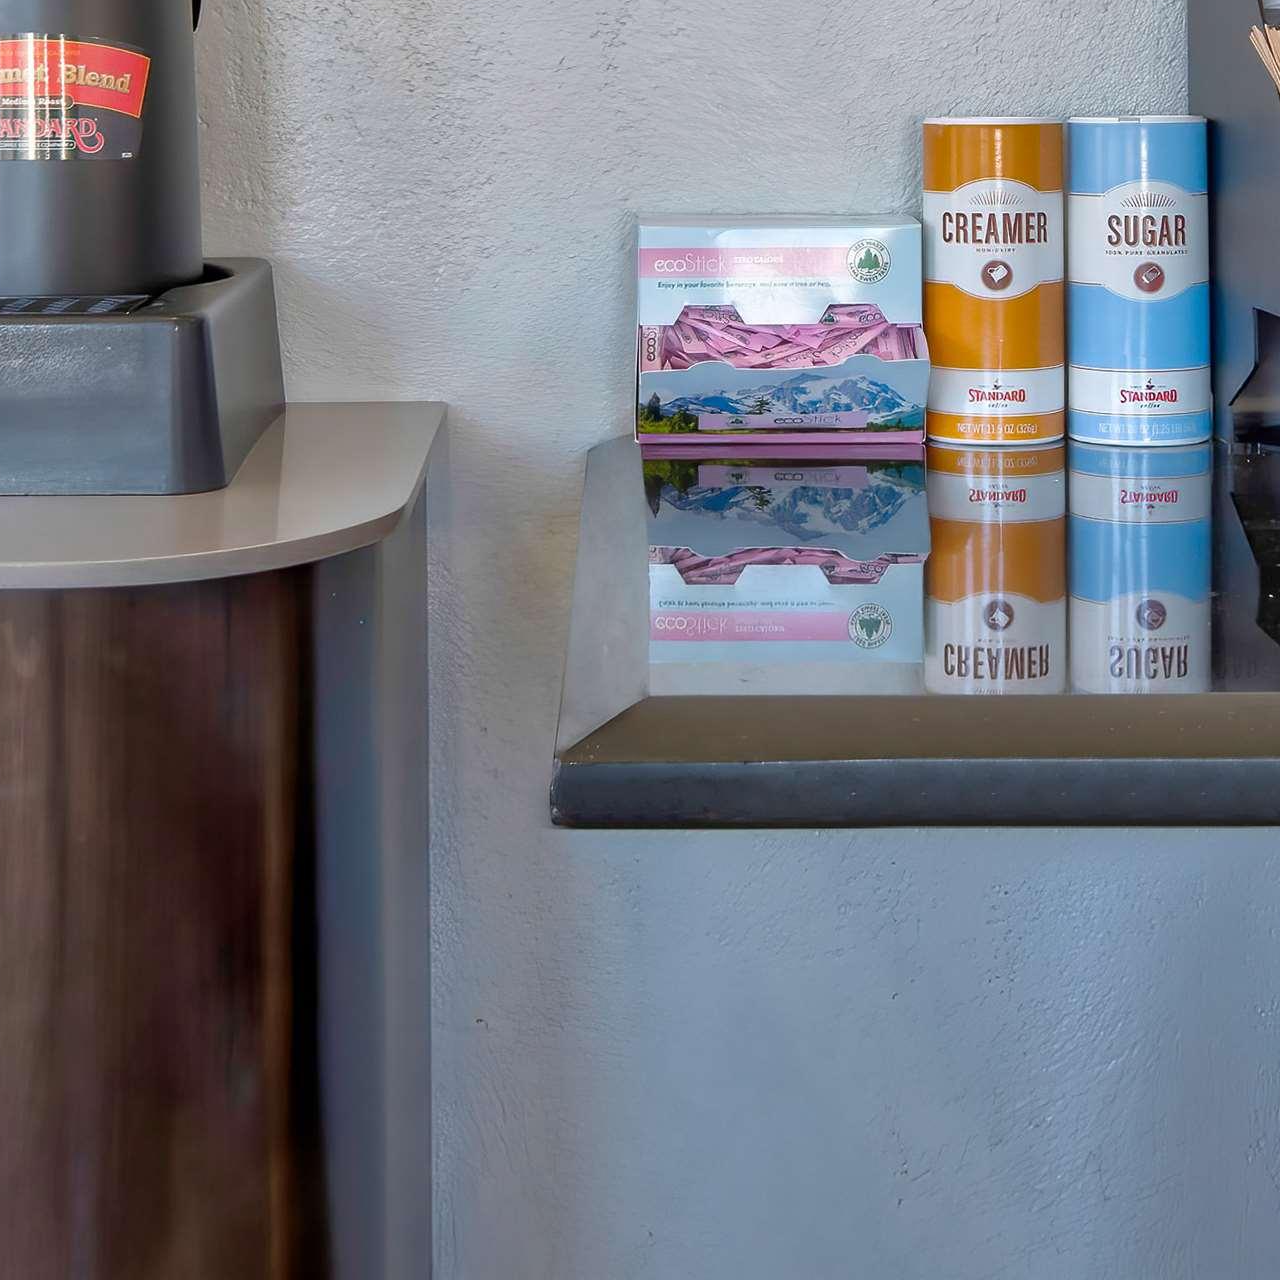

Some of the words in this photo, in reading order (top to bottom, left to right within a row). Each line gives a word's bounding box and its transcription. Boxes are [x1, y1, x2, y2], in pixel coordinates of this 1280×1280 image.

[58, 63, 132, 95] Blend
[942, 211, 1049, 244] CREAMER
[1107, 214, 1187, 247] SUGAR
[654, 253, 728, 273] ecoStick
[968, 388, 1026, 403] STANDARD
[1120, 388, 1178, 403] STANDARD
[956, 423, 971, 433] NET
[1004, 423, 1015, 434] OZ
